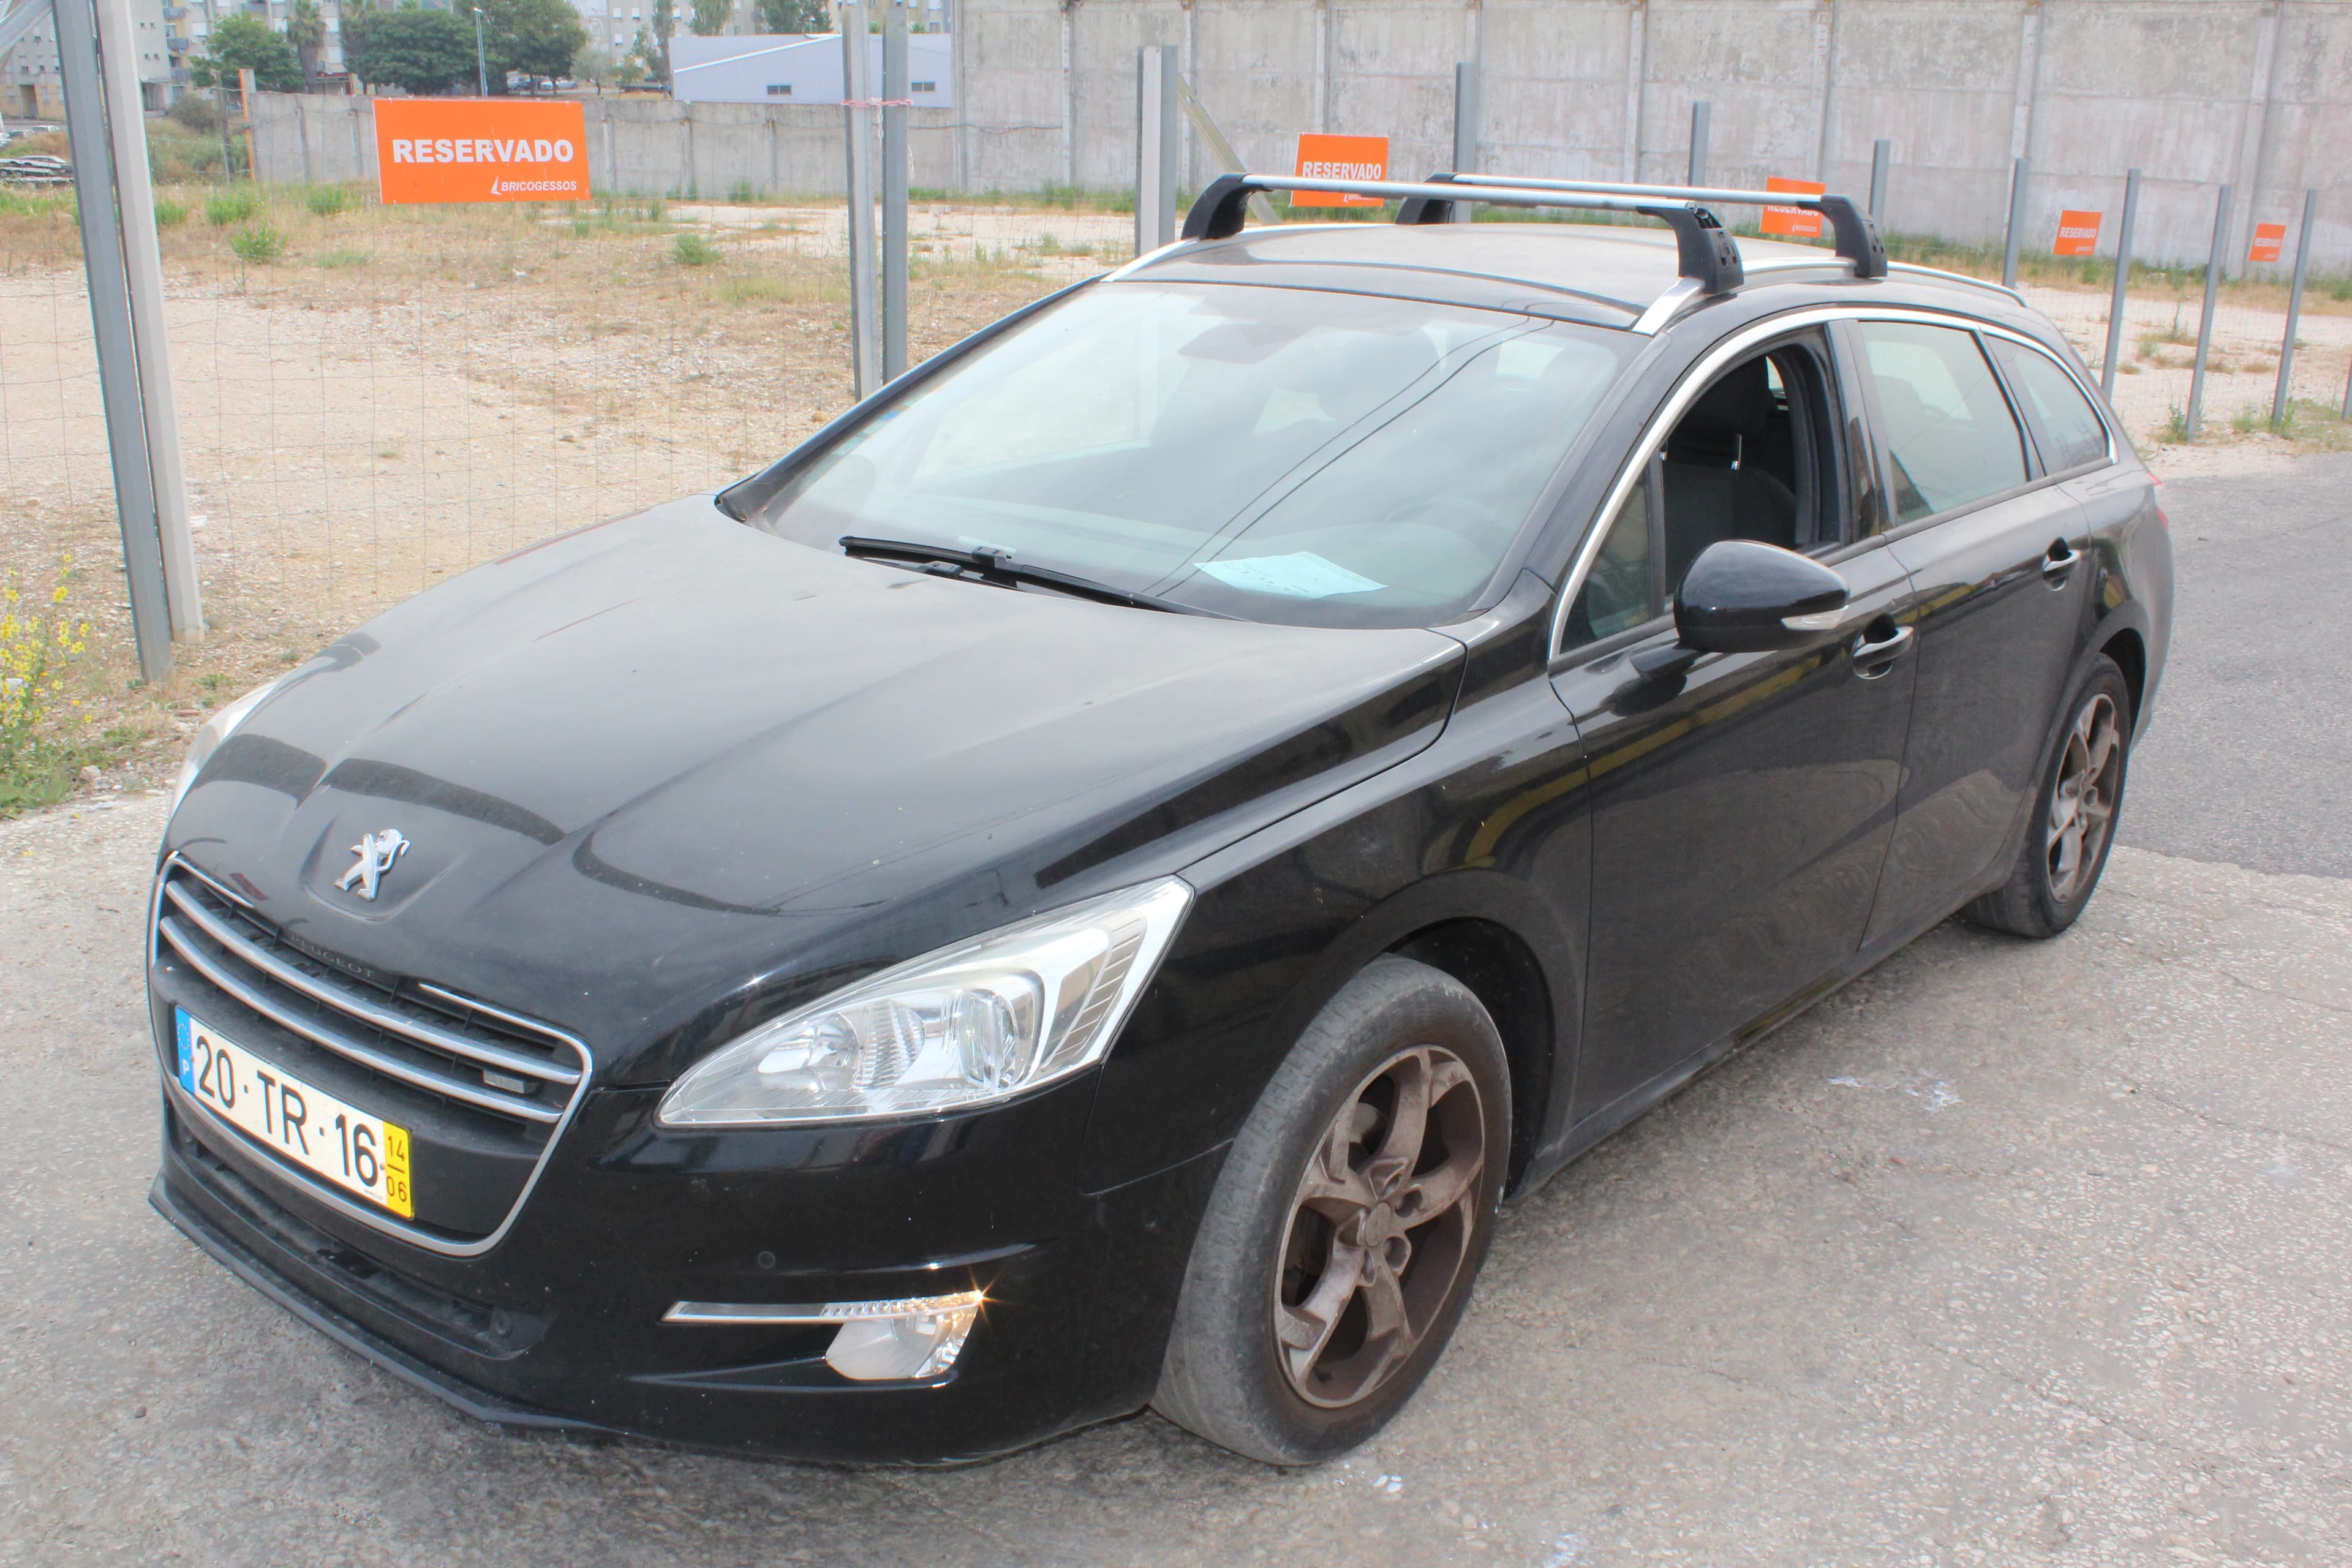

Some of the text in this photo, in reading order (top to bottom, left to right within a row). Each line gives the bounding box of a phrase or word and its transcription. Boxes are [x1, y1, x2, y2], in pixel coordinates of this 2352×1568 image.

[393, 139, 574, 163] RESERVADO
[1302, 161, 1382, 179] RESERVADO
[501, 181, 577, 191] BRICOGESSOS
[182, 1058, 190, 1076] P
[387, 1136, 405, 1162] 14
[386, 1176, 407, 1202] 06
